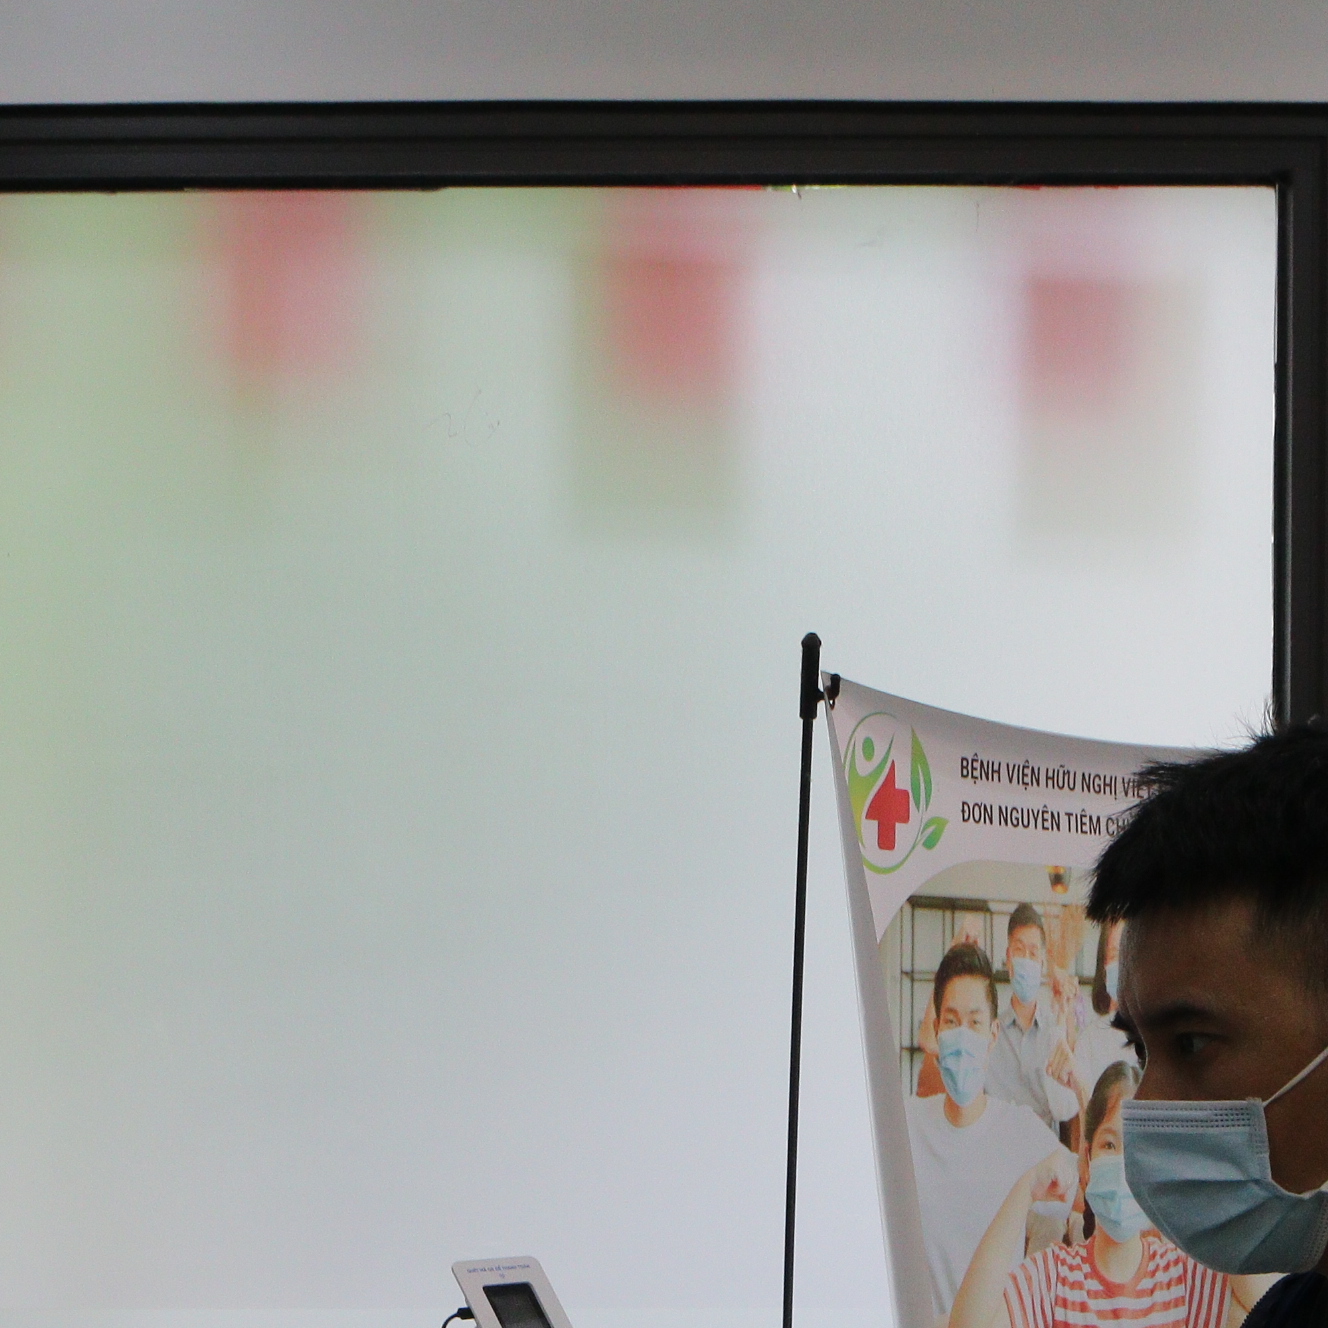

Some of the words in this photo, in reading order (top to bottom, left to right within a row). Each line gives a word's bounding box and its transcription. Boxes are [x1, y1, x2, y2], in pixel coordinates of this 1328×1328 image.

[960, 753, 1001, 785] BỆNH
[1006, 759, 1041, 791] VIỆN
[1045, 764, 1077, 792] HỮU
[1081, 772, 1118, 801] NGHỊ
[961, 801, 994, 826] ĐƠN
[998, 804, 1061, 832] NGUYÊN
[1065, 808, 1102, 836] TIÊM
